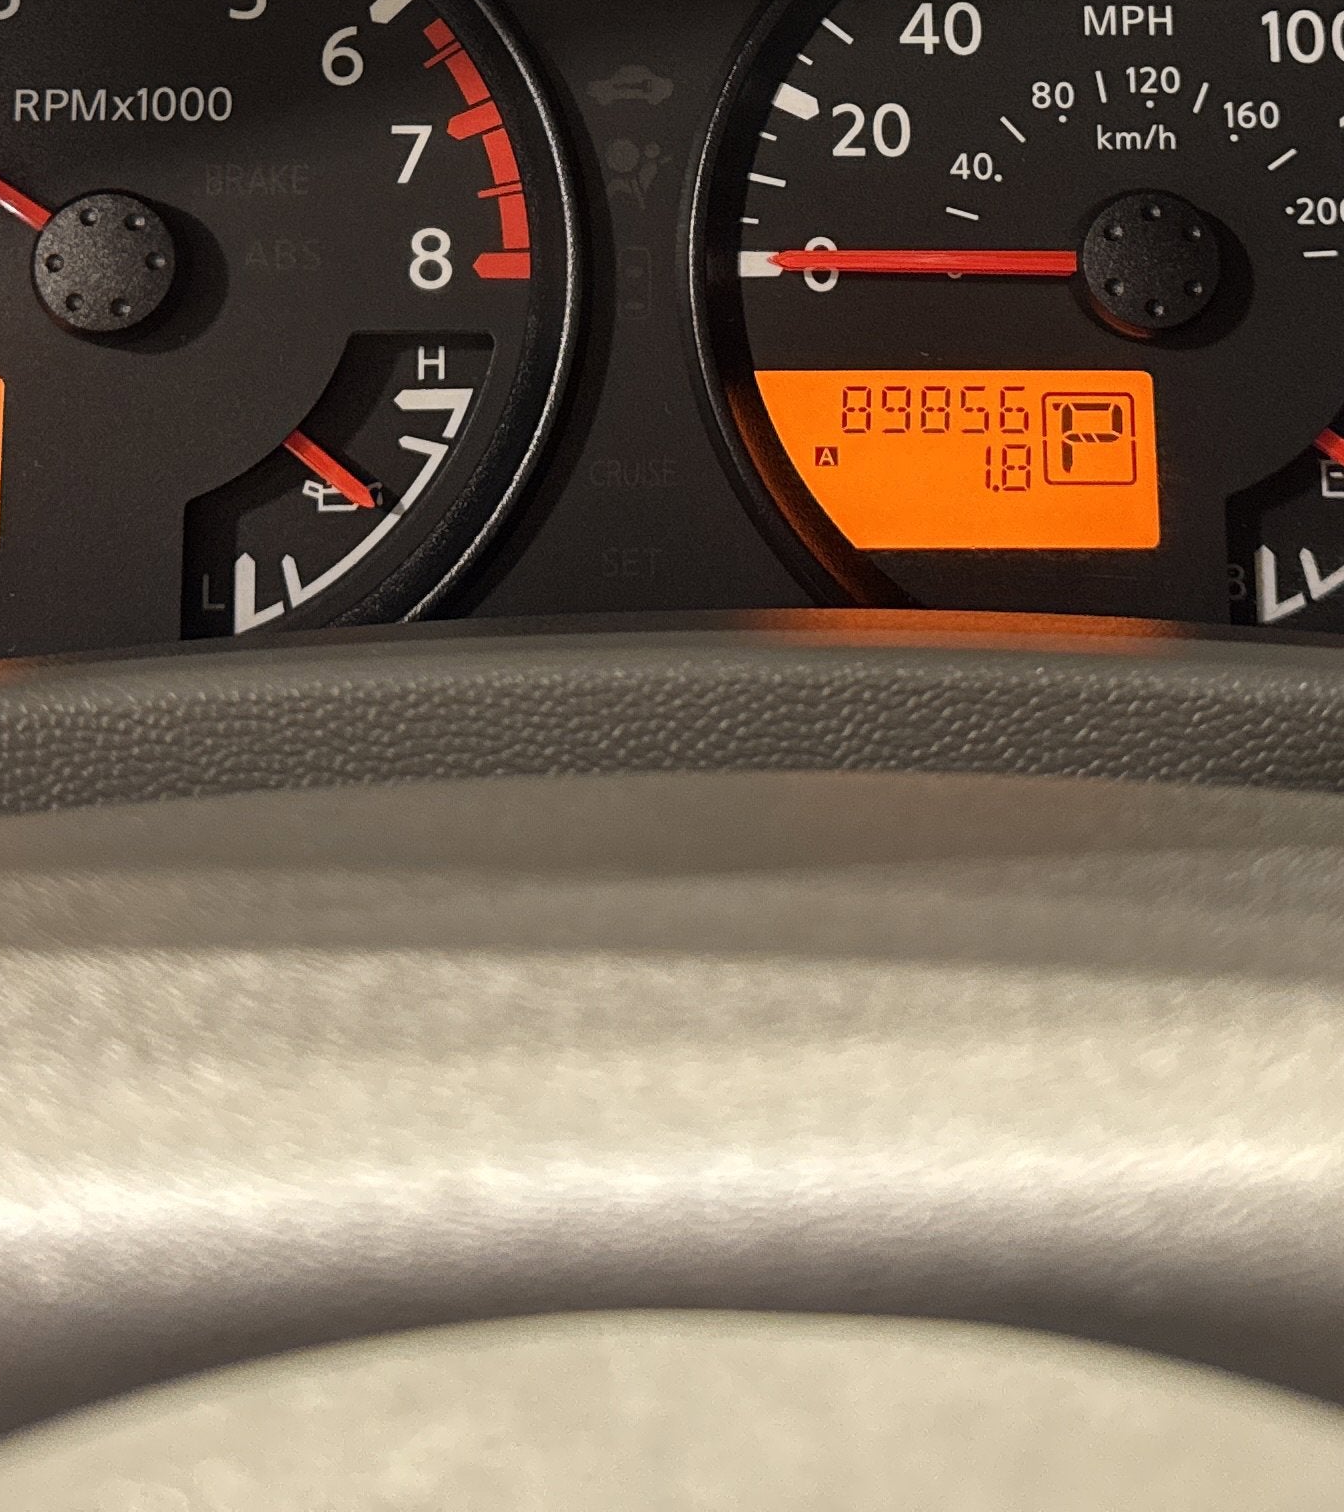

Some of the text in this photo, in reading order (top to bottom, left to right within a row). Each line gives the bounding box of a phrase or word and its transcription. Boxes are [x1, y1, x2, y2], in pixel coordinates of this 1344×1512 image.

[899, 1, 982, 56] 40
[1083, 5, 1173, 36] MPH
[321, 25, 364, 87] 6
[1031, 81, 1075, 109] 80
[1125, 65, 1181, 94] 120
[14, 86, 233, 122] RPMx1000
[1223, 100, 1280, 129] 160
[832, 102, 911, 158] 20
[1096, 124, 1177, 150] km/h
[391, 124, 433, 184] 7
[949, 152, 993, 181] 40
[205, 164, 309, 196] BRAKE
[244, 237, 322, 270] ABS
[409, 227, 453, 291] 8
[417, 346, 446, 381] H
[840, 386, 1031, 435] 89856
[1053, 402, 1124, 474] P
[983, 444, 1033, 493] 1.8
[202, 573, 226, 611] L
